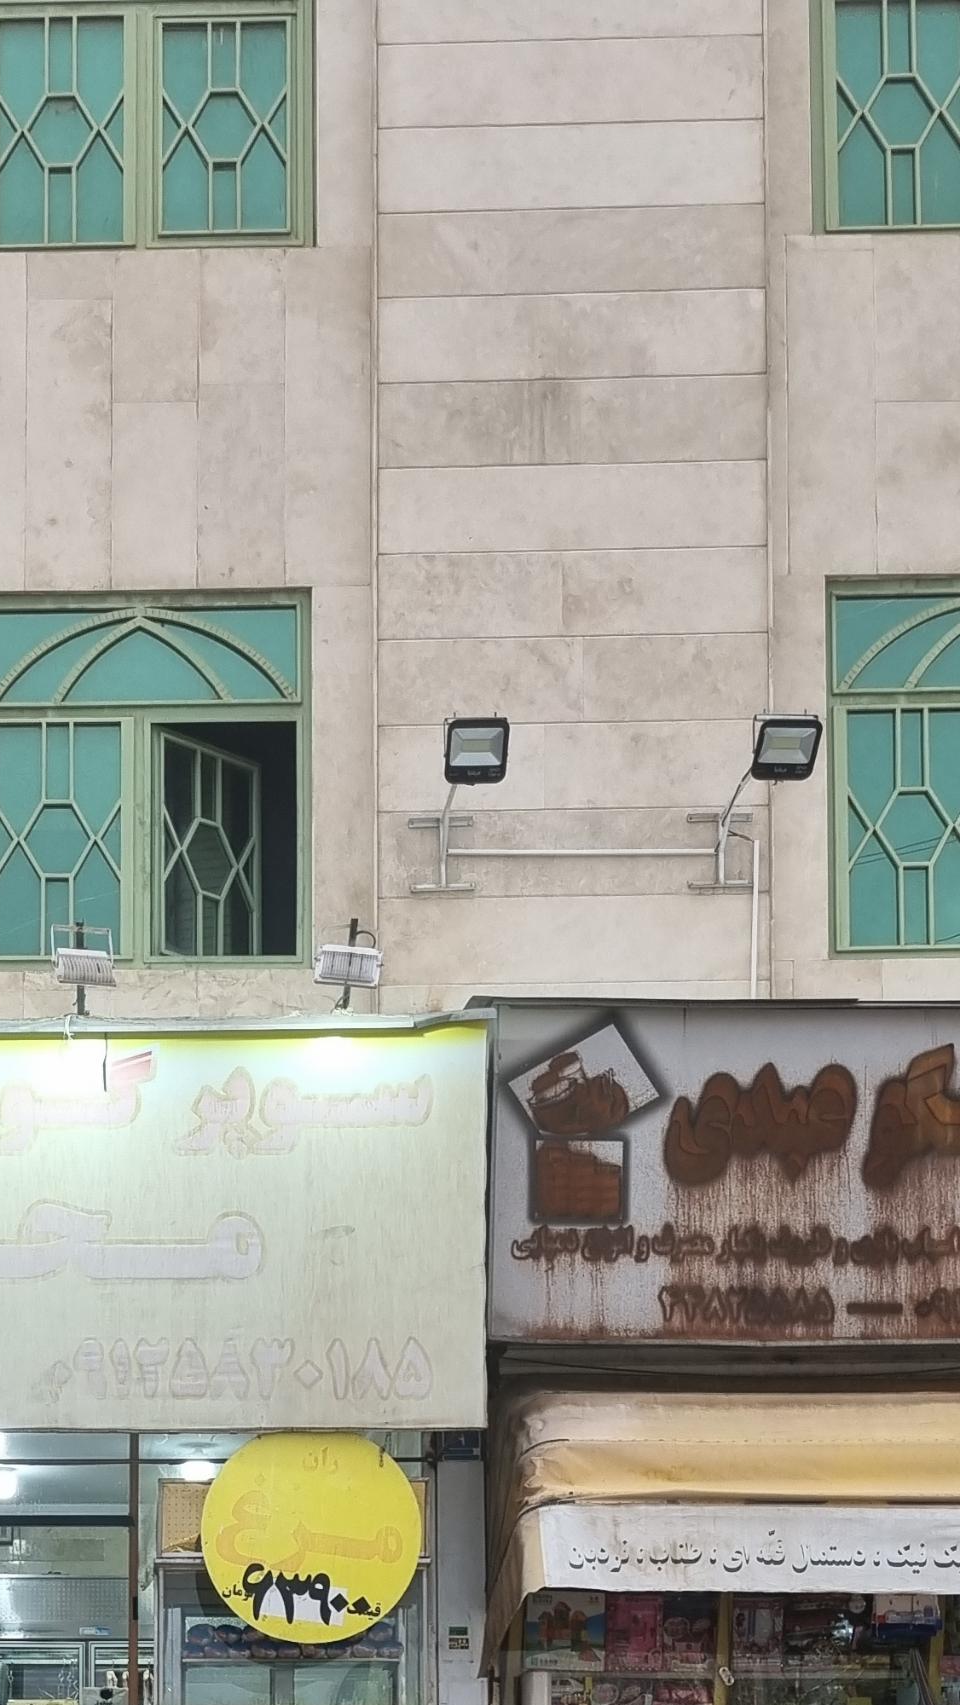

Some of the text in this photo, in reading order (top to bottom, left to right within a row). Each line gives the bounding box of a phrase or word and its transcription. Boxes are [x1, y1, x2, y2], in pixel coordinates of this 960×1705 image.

[173, 1066, 434, 1160] سوپر
[634, 1235, 651, 1263] و
[302, 1447, 338, 1474] ران
[215, 1474, 403, 1573] مرغ
[347, 1601, 382, 1620] قیت
